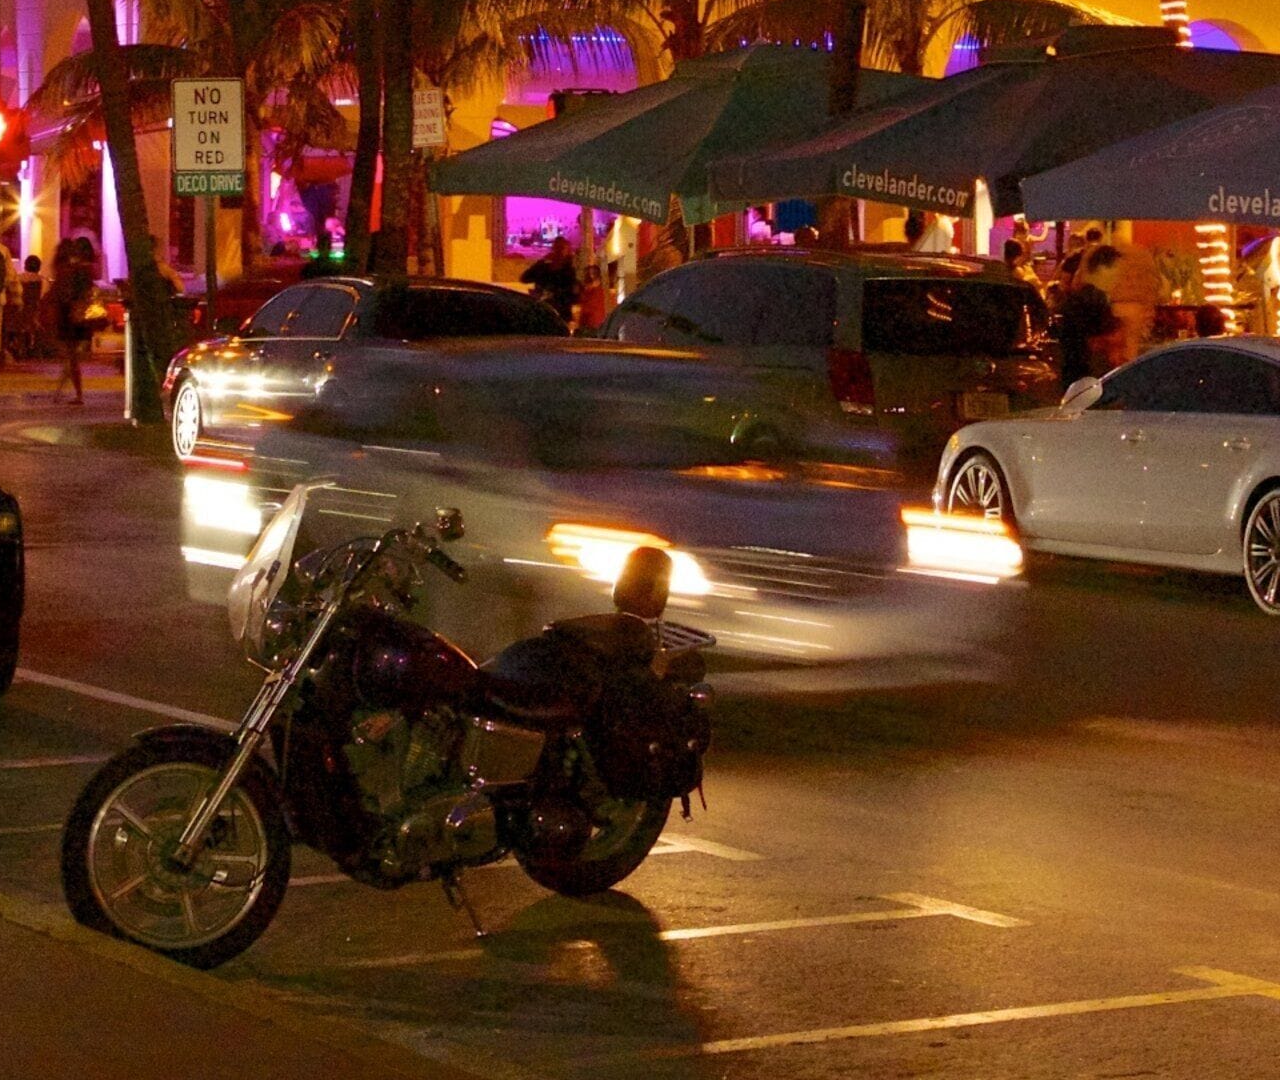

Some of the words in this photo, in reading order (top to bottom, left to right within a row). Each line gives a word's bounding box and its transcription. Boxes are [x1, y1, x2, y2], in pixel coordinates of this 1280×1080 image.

[194, 88, 221, 105] NO
[187, 110, 229, 125] TURN
[198, 130, 220, 144] ON
[194, 150, 224, 165] RED
[177, 175, 208, 192] DECO
[210, 174, 243, 191] DRIVE
[842, 163, 969, 208] clevelander.com
[548, 171, 662, 217] clevelander.com
